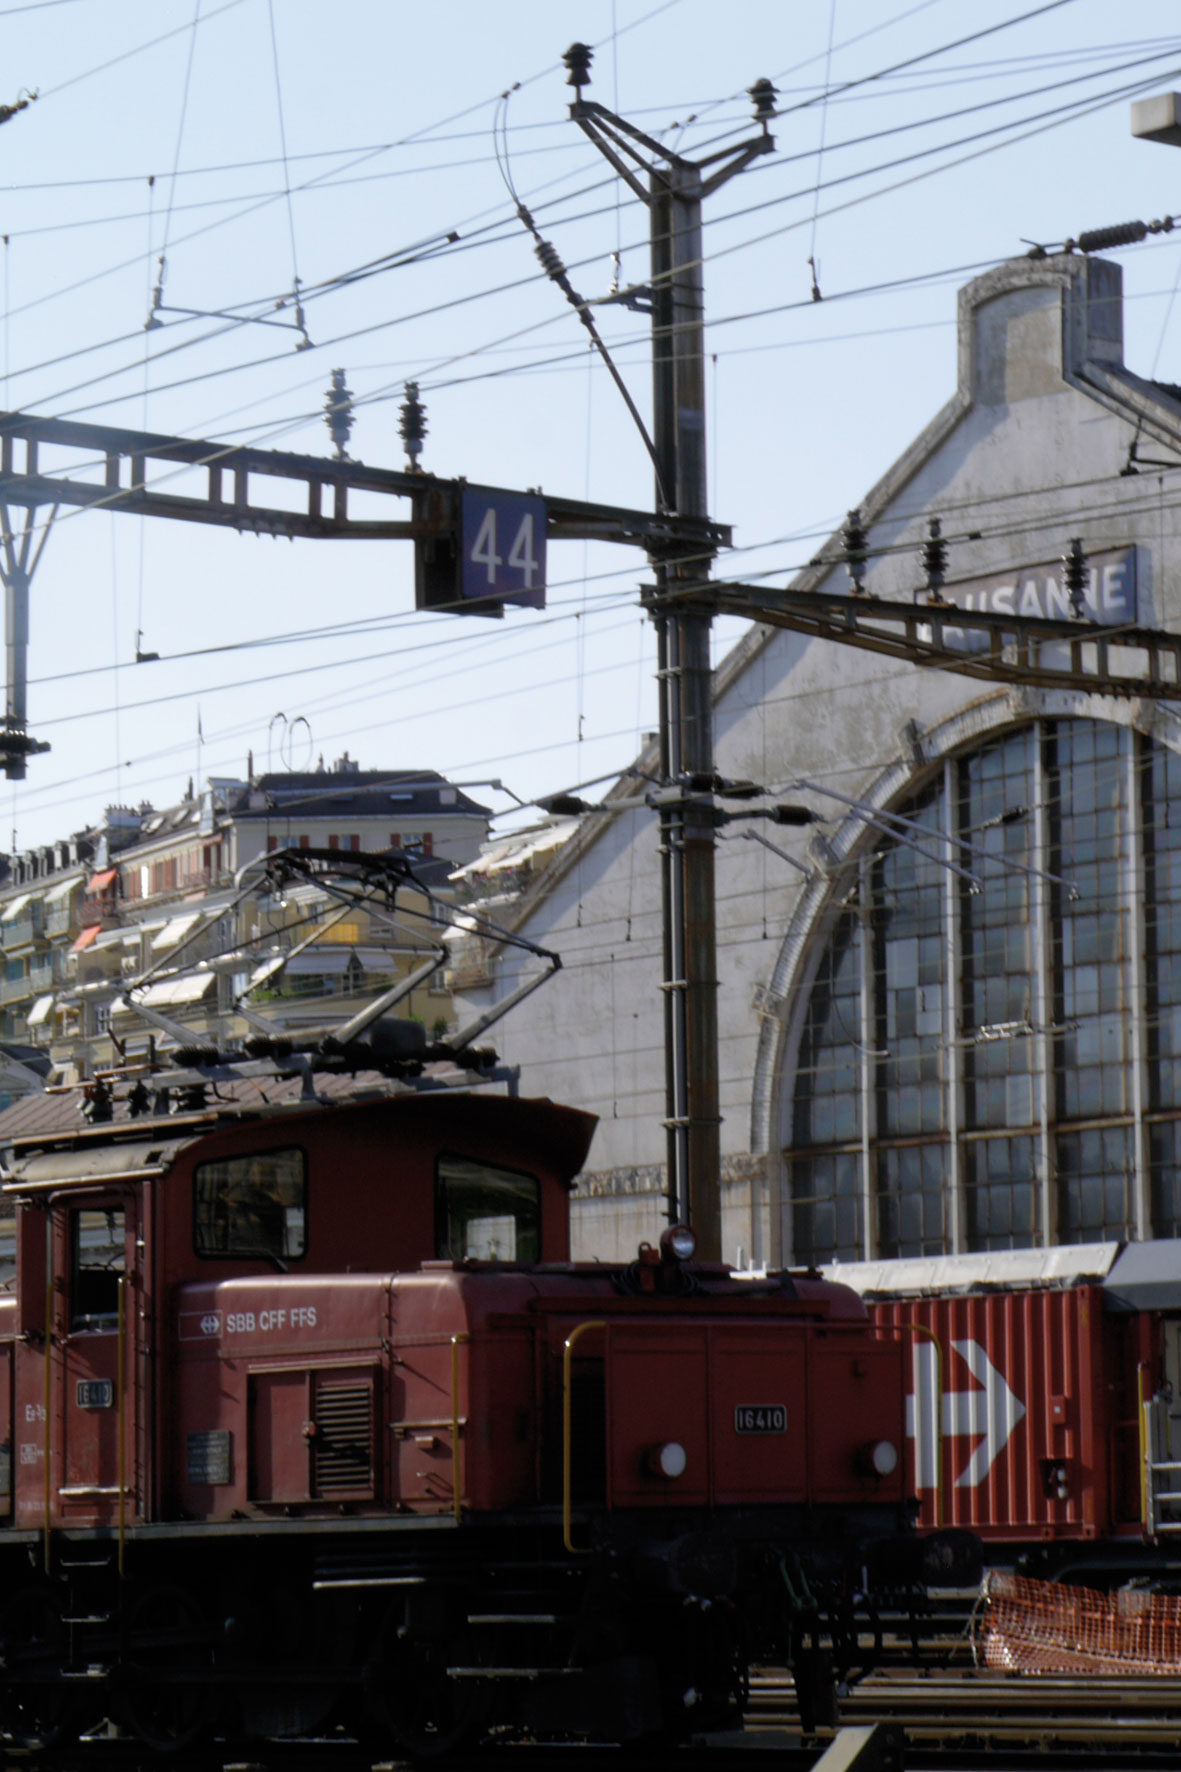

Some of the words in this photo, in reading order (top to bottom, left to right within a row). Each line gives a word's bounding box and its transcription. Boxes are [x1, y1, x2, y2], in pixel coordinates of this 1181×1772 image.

[470, 507, 539, 589] 44
[226, 1313, 256, 1333] SBB
[259, 1309, 286, 1331] CFF
[290, 1306, 317, 1328] FFS
[738, 1409, 784, 1430] 16410
